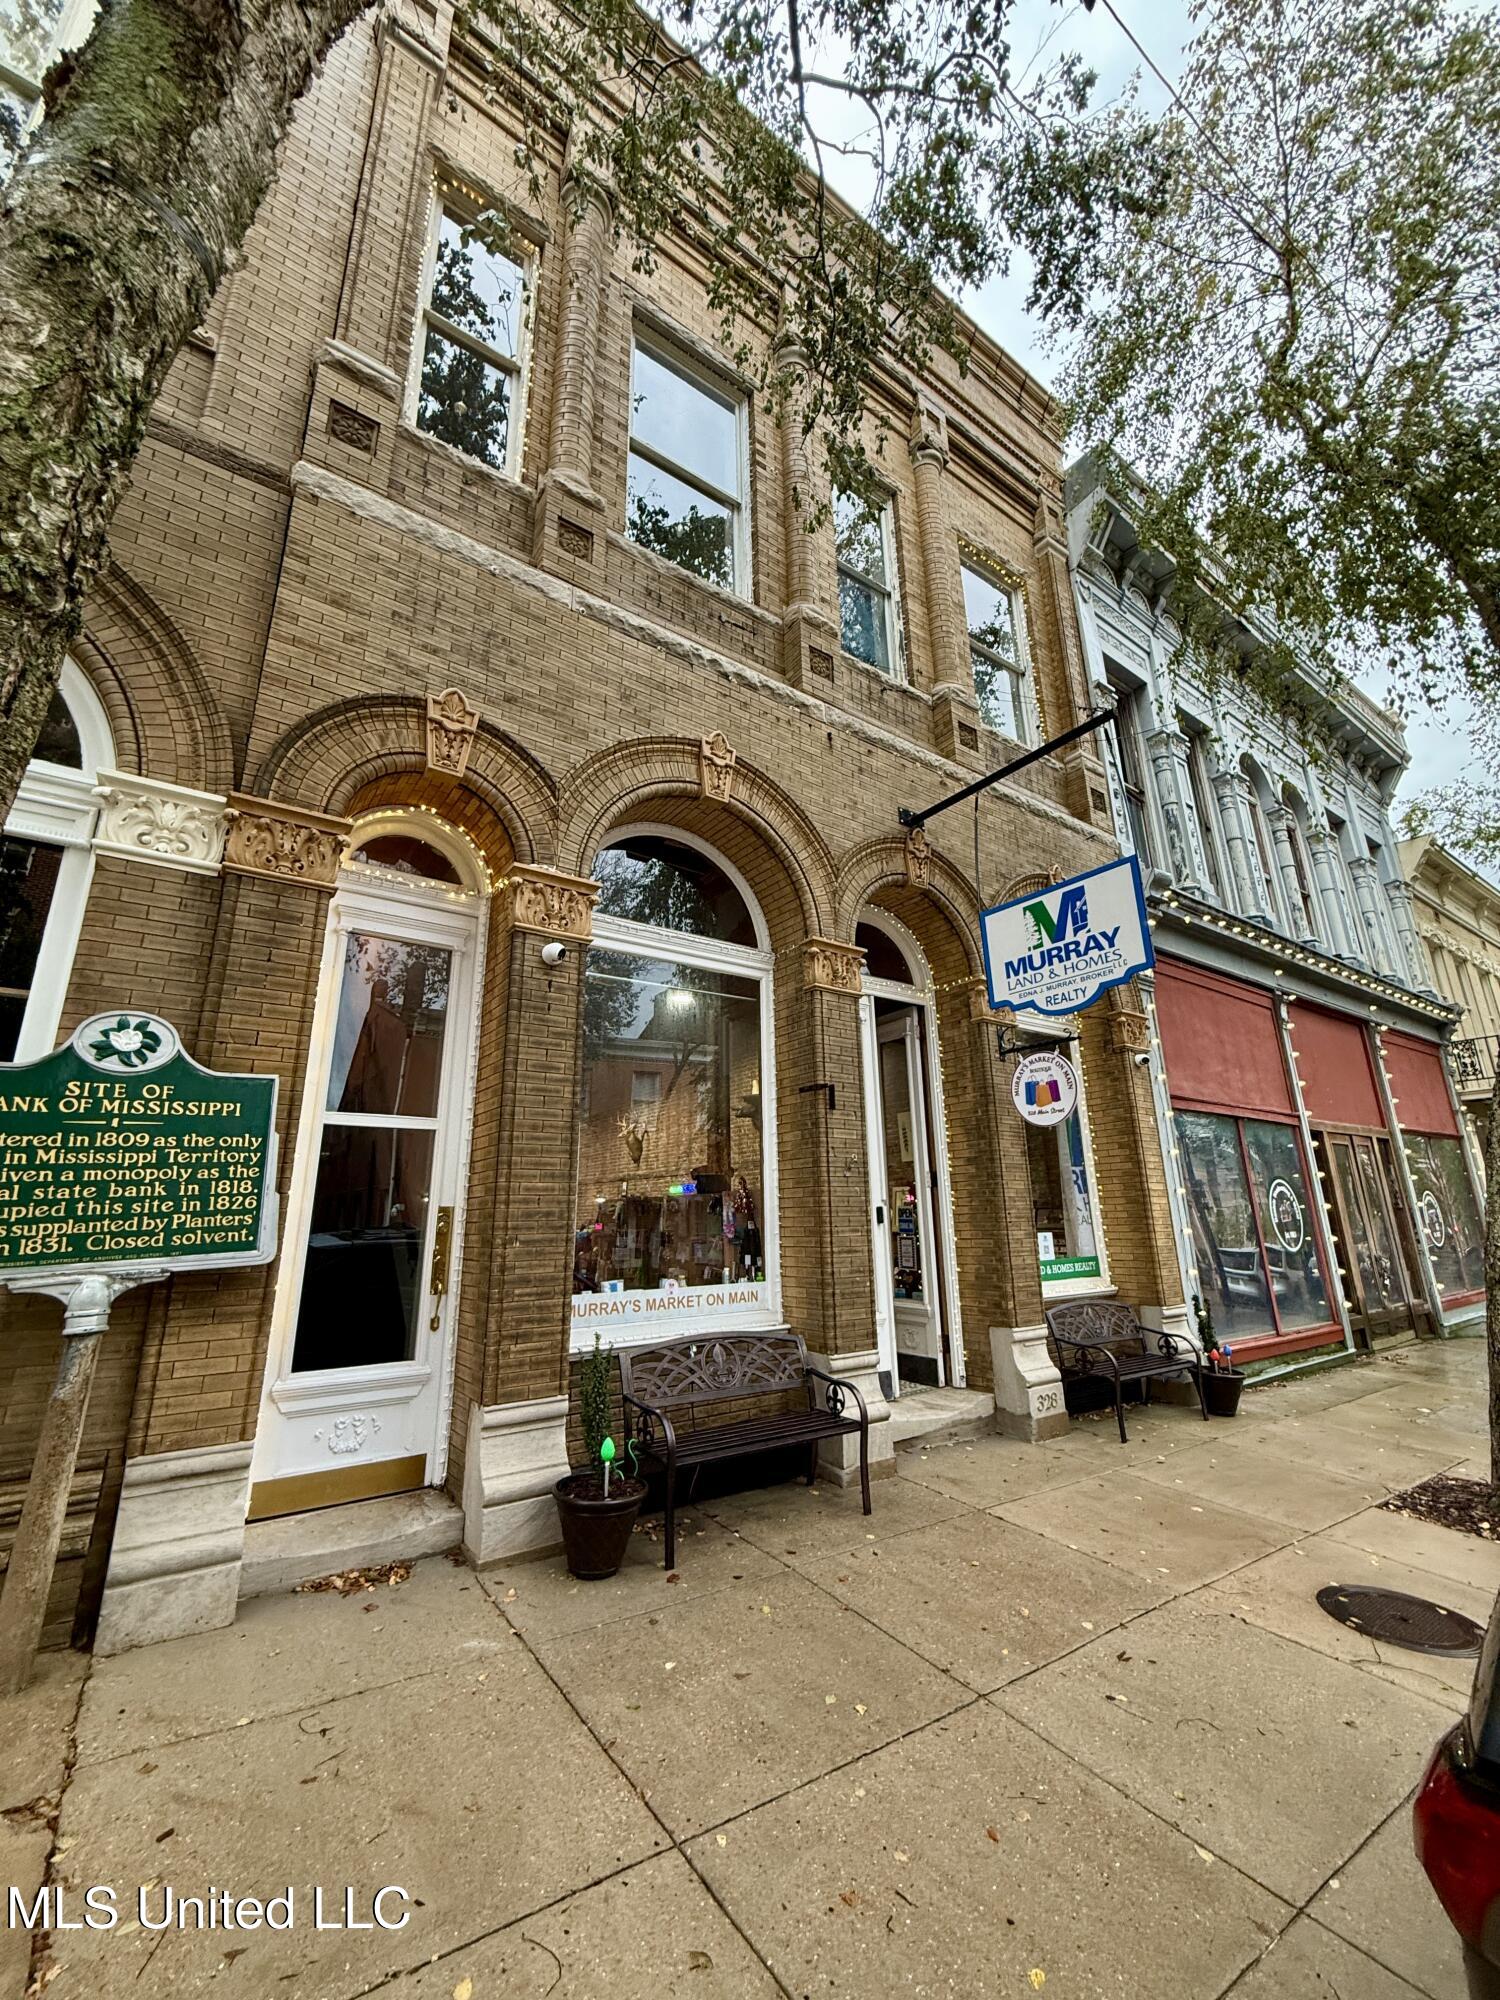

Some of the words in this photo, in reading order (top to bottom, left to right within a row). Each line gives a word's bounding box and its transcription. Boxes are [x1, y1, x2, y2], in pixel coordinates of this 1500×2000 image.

[1004, 925, 1121, 979] MURRAY
[1007, 971, 1044, 991] LAND
[1048, 967, 1060, 979] &
[1063, 948, 1122, 975] HOMES
[1113, 958, 1128, 970] LLC
[1018, 989, 1038, 999] EDNA
[1080, 968, 1114, 983] BROKER
[1045, 985, 1088, 1008] REALTY
[1028, 1055, 1056, 1066] MARKET
[1055, 1060, 1066, 1071] ON
[1062, 1070, 1074, 1091] MAIN
[65, 1081, 127, 1098] SITE
[142, 1084, 174, 1099] OF
[58, 1097, 93, 1113] OF
[100, 1099, 241, 1117] MISSISSIPPI
[68, 1133, 89, 1147] in
[94, 1132, 150, 1147] 1809
[153, 1136, 177, 1147] as
[182, 1133, 215, 1147] the
[219, 1133, 263, 1150] only
[3, 1149, 28, 1165] in
[35, 1149, 157, 1167] Mississippi
[165, 1149, 262, 1165] Territory
[60, 1170, 75, 1181] a
[83, 1165, 192, 1183] monopoly
[197, 1168, 220, 1179] as
[227, 1165, 260, 1178] the
[33, 1184, 97, 1199] state
[108, 1182, 167, 1198] bank
[178, 1182, 200, 1196] in
[210, 1180, 259, 1195] 1818.
[75, 1200, 123, 1216] this
[130, 1199, 175, 1214] site
[181, 1198, 201, 1212] in
[208, 1195, 258, 1211] 1826
[9, 1217, 139, 1239] supplanted
[141, 1216, 169, 1232] by
[171, 1210, 257, 1229] Planters'
[18, 1237, 74, 1255] 1831.
[86, 1233, 165, 1251] Closed
[170, 1228, 255, 1246] solvent.
[1047, 1264, 1052, 1275] &
[1052, 1263, 1075, 1274] HOMES
[1074, 1261, 1096, 1272] REALTY
[645, 1294, 703, 1312] MARKET
[706, 1293, 725, 1306] ON
[728, 1290, 759, 1305] MAIN
[1036, 1391, 1058, 1413] 328
